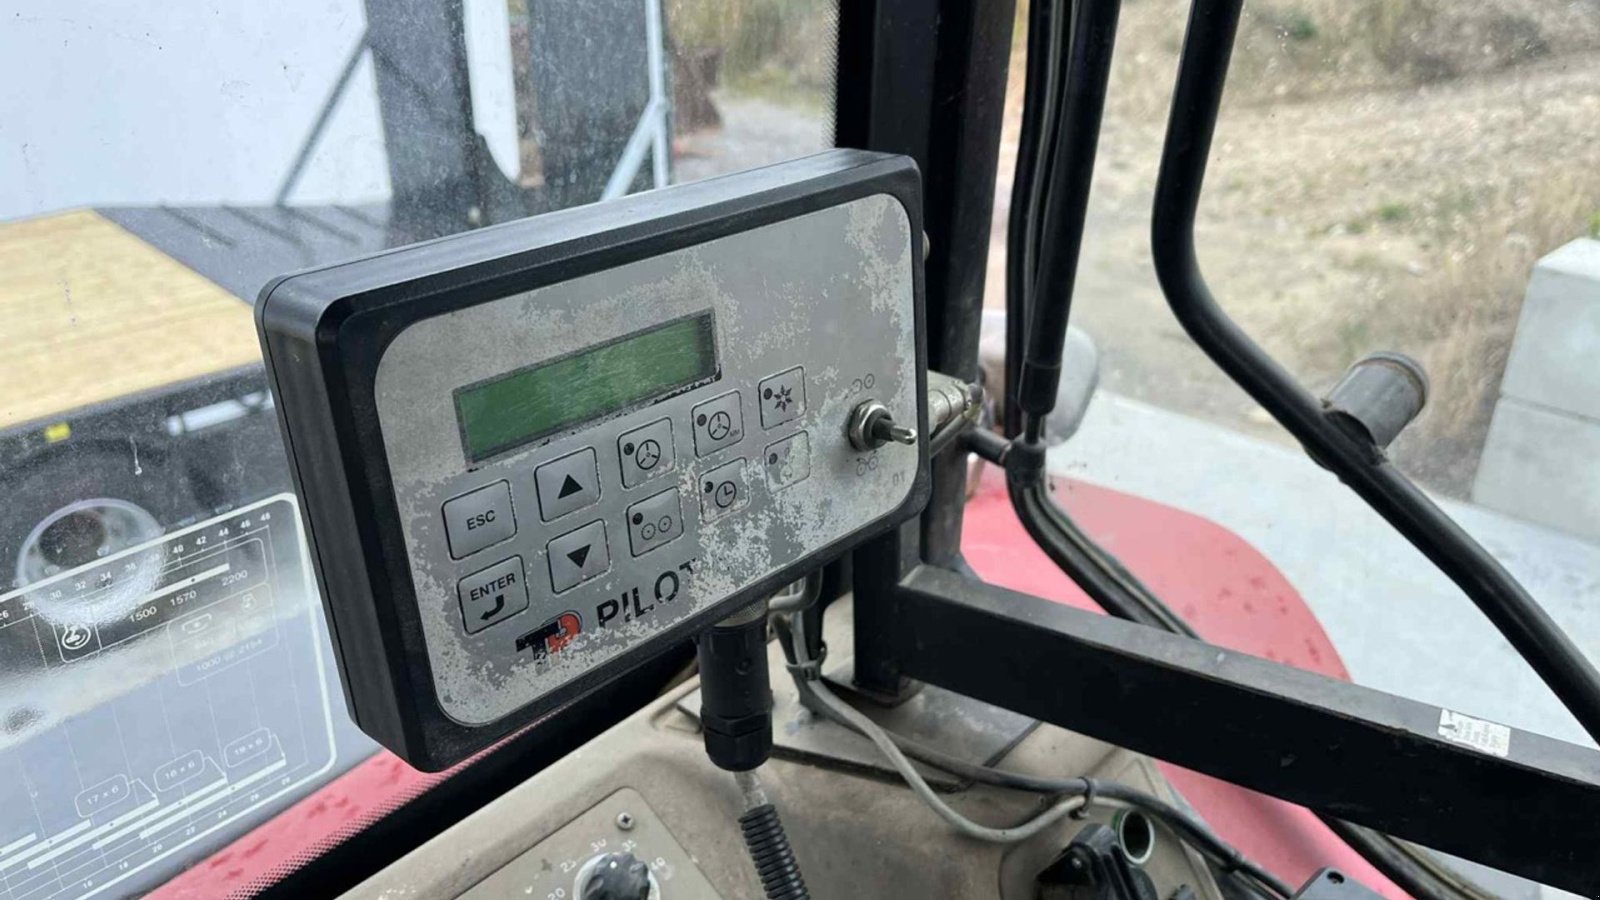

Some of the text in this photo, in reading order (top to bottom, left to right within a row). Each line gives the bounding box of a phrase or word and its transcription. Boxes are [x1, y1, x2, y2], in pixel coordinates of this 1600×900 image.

[466, 509, 496, 531] ESC
[74, 580, 87, 591] 32
[100, 571, 112, 582] 34
[173, 544, 184, 554] 40
[196, 536, 207, 546] 42
[218, 527, 230, 537] 44
[129, 569, 248, 623] 1500 1570 2200
[470, 573, 516, 602] ENTER
[87, 794, 99, 806] 17
[590, 838, 607, 853] 30
